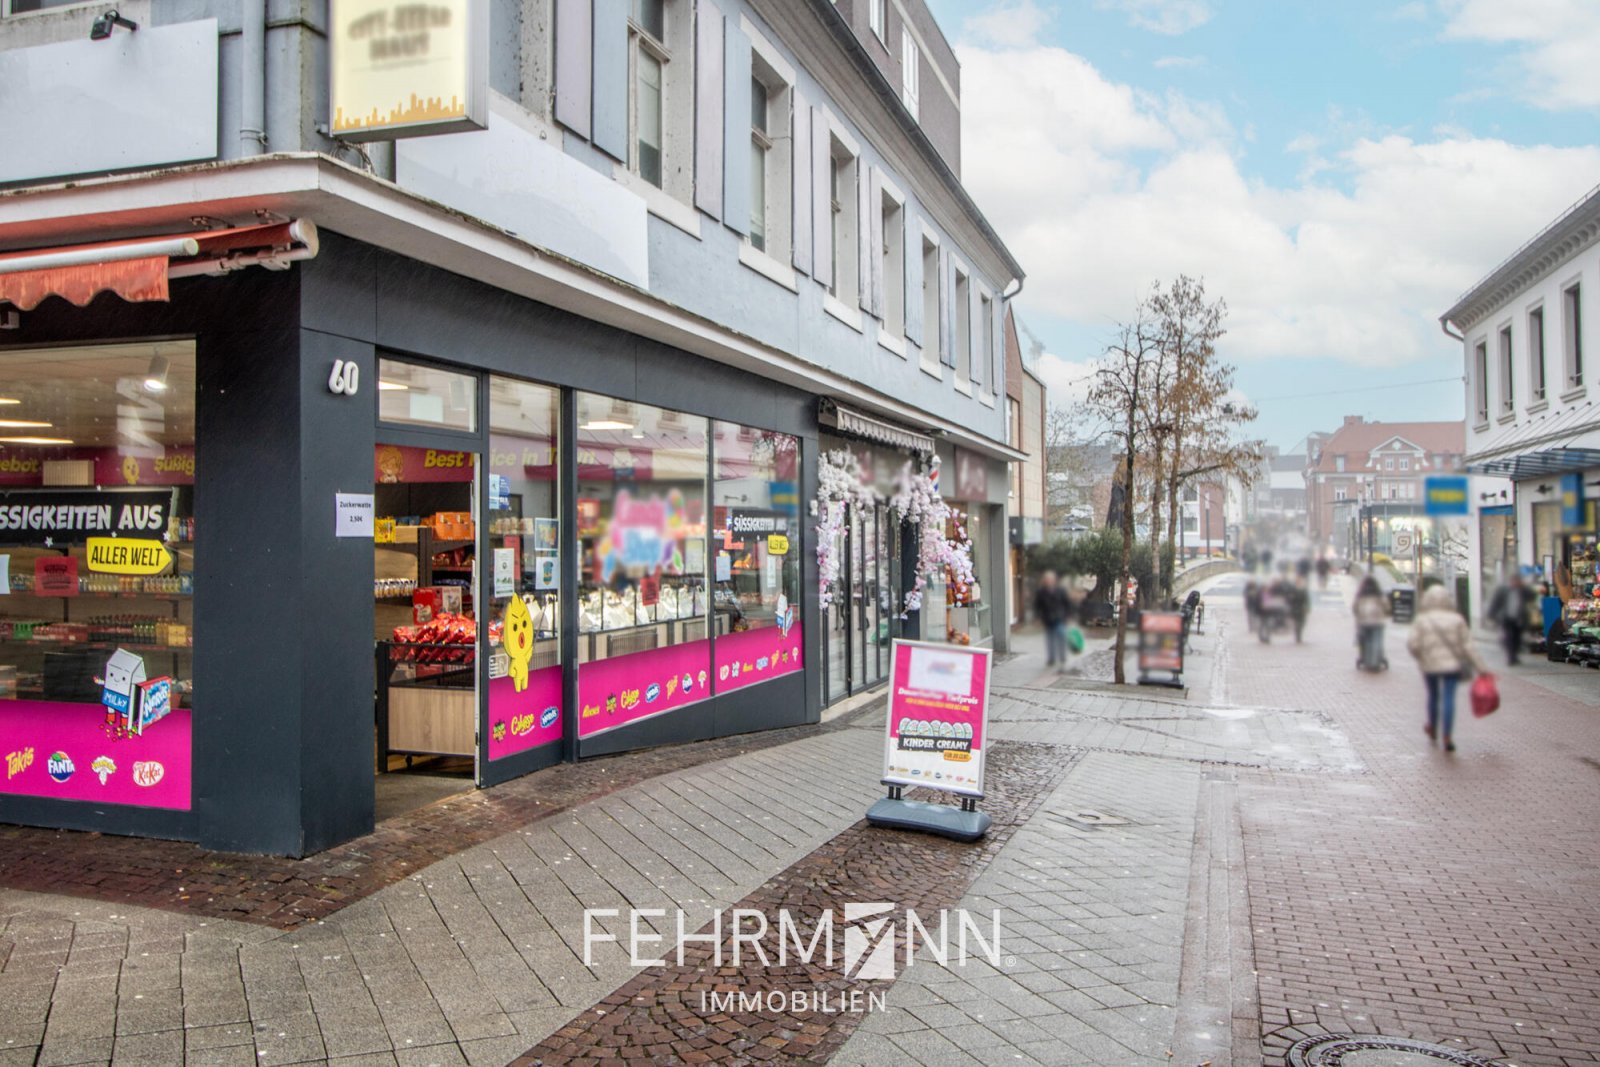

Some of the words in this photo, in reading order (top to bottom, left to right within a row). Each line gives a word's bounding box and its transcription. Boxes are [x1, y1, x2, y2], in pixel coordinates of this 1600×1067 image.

[328, 359, 359, 395] 60
[424, 450, 465, 468] Best
[117, 504, 163, 531] AUS
[91, 545, 128, 565] ALLER
[131, 547, 163, 567] WELT
[902, 737, 935, 749] KINDER
[936, 740, 969, 750] CREAMY
[5, 747, 35, 781] Takis
[47, 758, 75, 774] FANTA
